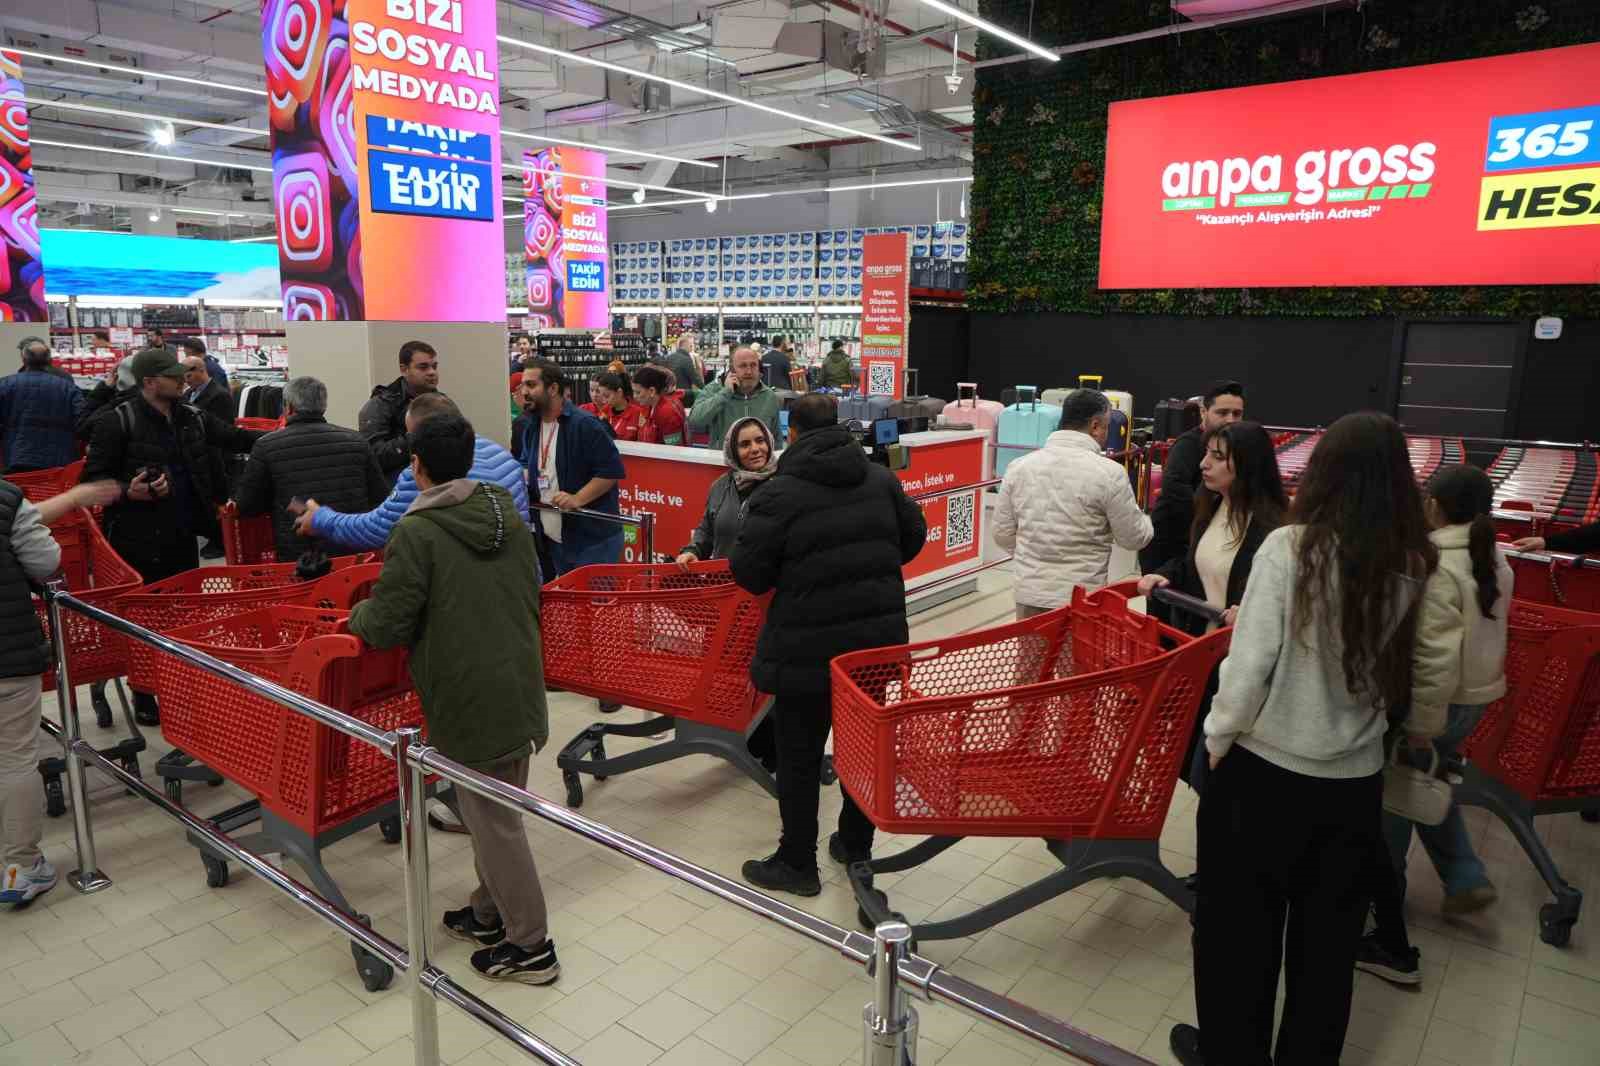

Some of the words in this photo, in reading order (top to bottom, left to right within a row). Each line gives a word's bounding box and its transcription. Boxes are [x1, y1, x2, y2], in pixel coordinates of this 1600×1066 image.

[353, 22, 495, 80] SOSYAL
[353, 64, 497, 115] MEDYADA
[1488, 120, 1594, 162] 365
[1162, 155, 1282, 207] anpa
[1294, 142, 1437, 205] gross
[572, 211, 597, 228] BİZİ
[562, 228, 605, 243] SOSYAL
[570, 262, 601, 275] TAKİP
[572, 275, 601, 289] EDİN
[634, 484, 665, 505] İstek
[667, 495, 684, 507] ve
